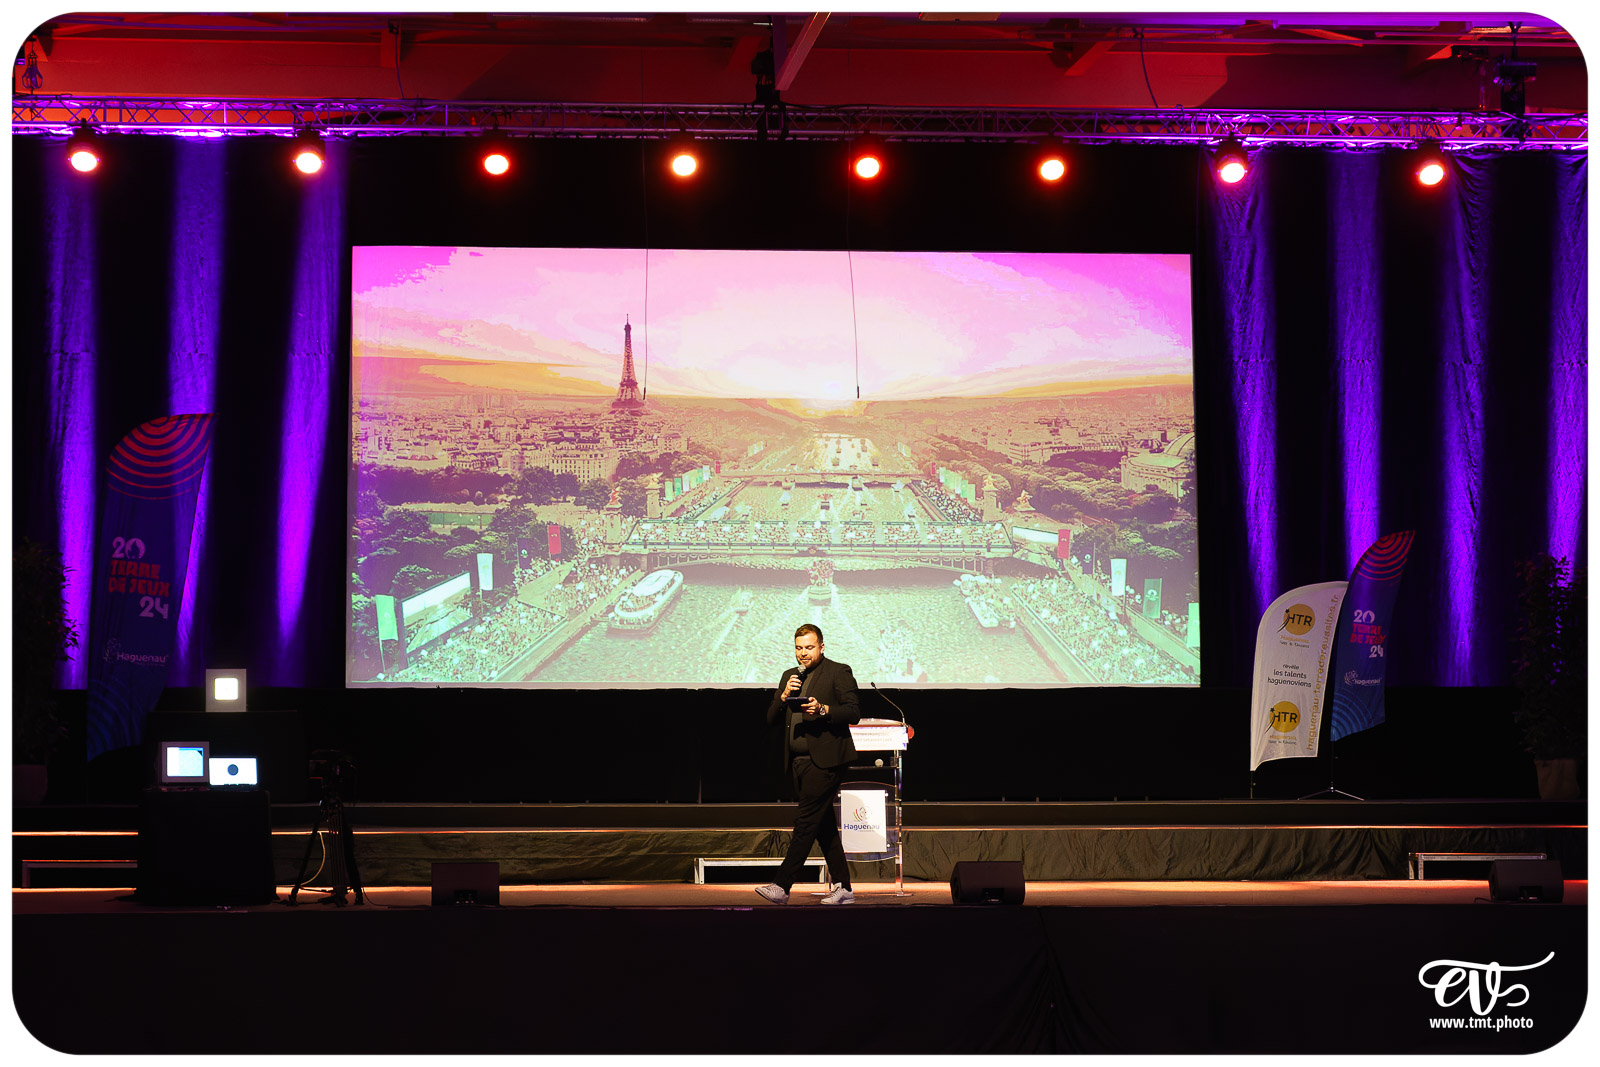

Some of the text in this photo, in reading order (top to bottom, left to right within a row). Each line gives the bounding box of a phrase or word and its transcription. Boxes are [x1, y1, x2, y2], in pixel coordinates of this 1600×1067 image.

[111, 536, 146, 559] 20
[111, 559, 161, 579] TERRE
[108, 577, 170, 597] DE JEUX
[139, 596, 169, 619] 24
[1287, 613, 1313, 627] HTR
[1353, 609, 1375, 624] 20
[116, 652, 166, 663] Haguenau
[1369, 644, 1384, 658] 24
[1267, 676, 1312, 688] haguenoviens
[1284, 670, 1307, 680] talents
[1273, 711, 1298, 724] HTR
[843, 823, 880, 831] Haguenau
